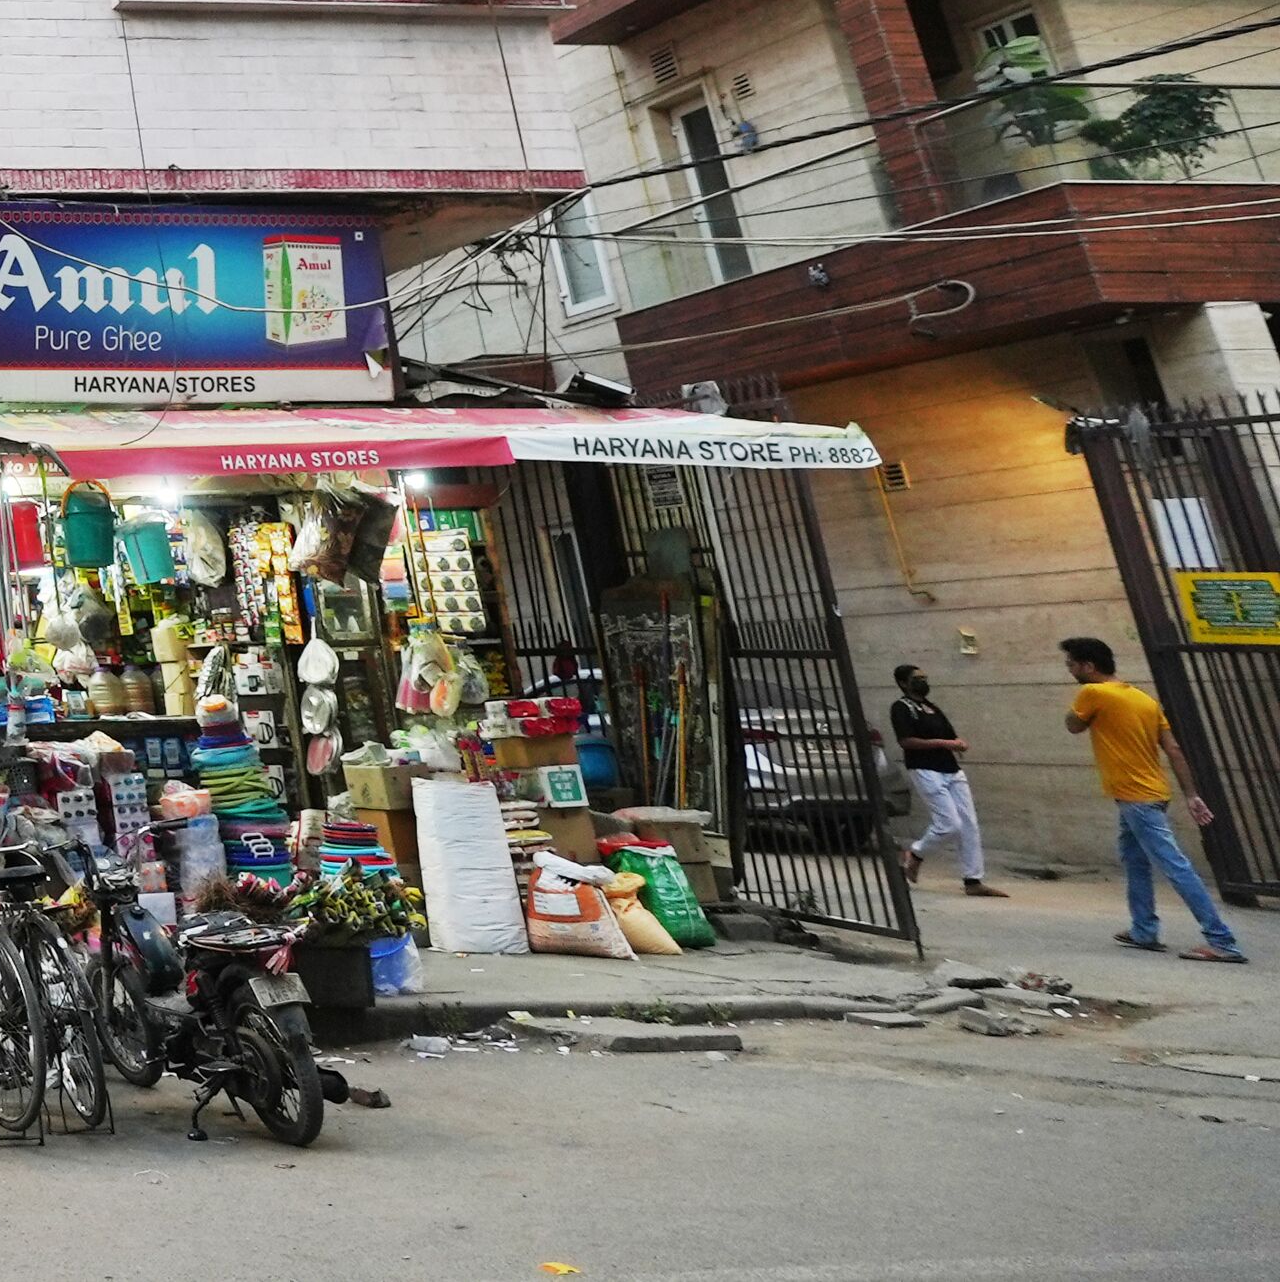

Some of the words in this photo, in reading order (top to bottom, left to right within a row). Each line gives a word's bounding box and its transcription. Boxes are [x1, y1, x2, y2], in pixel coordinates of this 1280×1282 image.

[296, 258, 332, 270] Amul
[35, 325, 91, 351] Pure
[103, 325, 162, 352] Ghee
[74, 376, 170, 394] HARYANA
[176, 376, 256, 393] STORES
[221, 453, 306, 471] HARYANA
[311, 449, 380, 468] STORES
[573, 437, 694, 460] HARYANA
[700, 441, 783, 462] STORE
[789, 446, 824, 463] PH:
[829, 447, 877, 464] 8882
[7, 460, 24, 474] to
